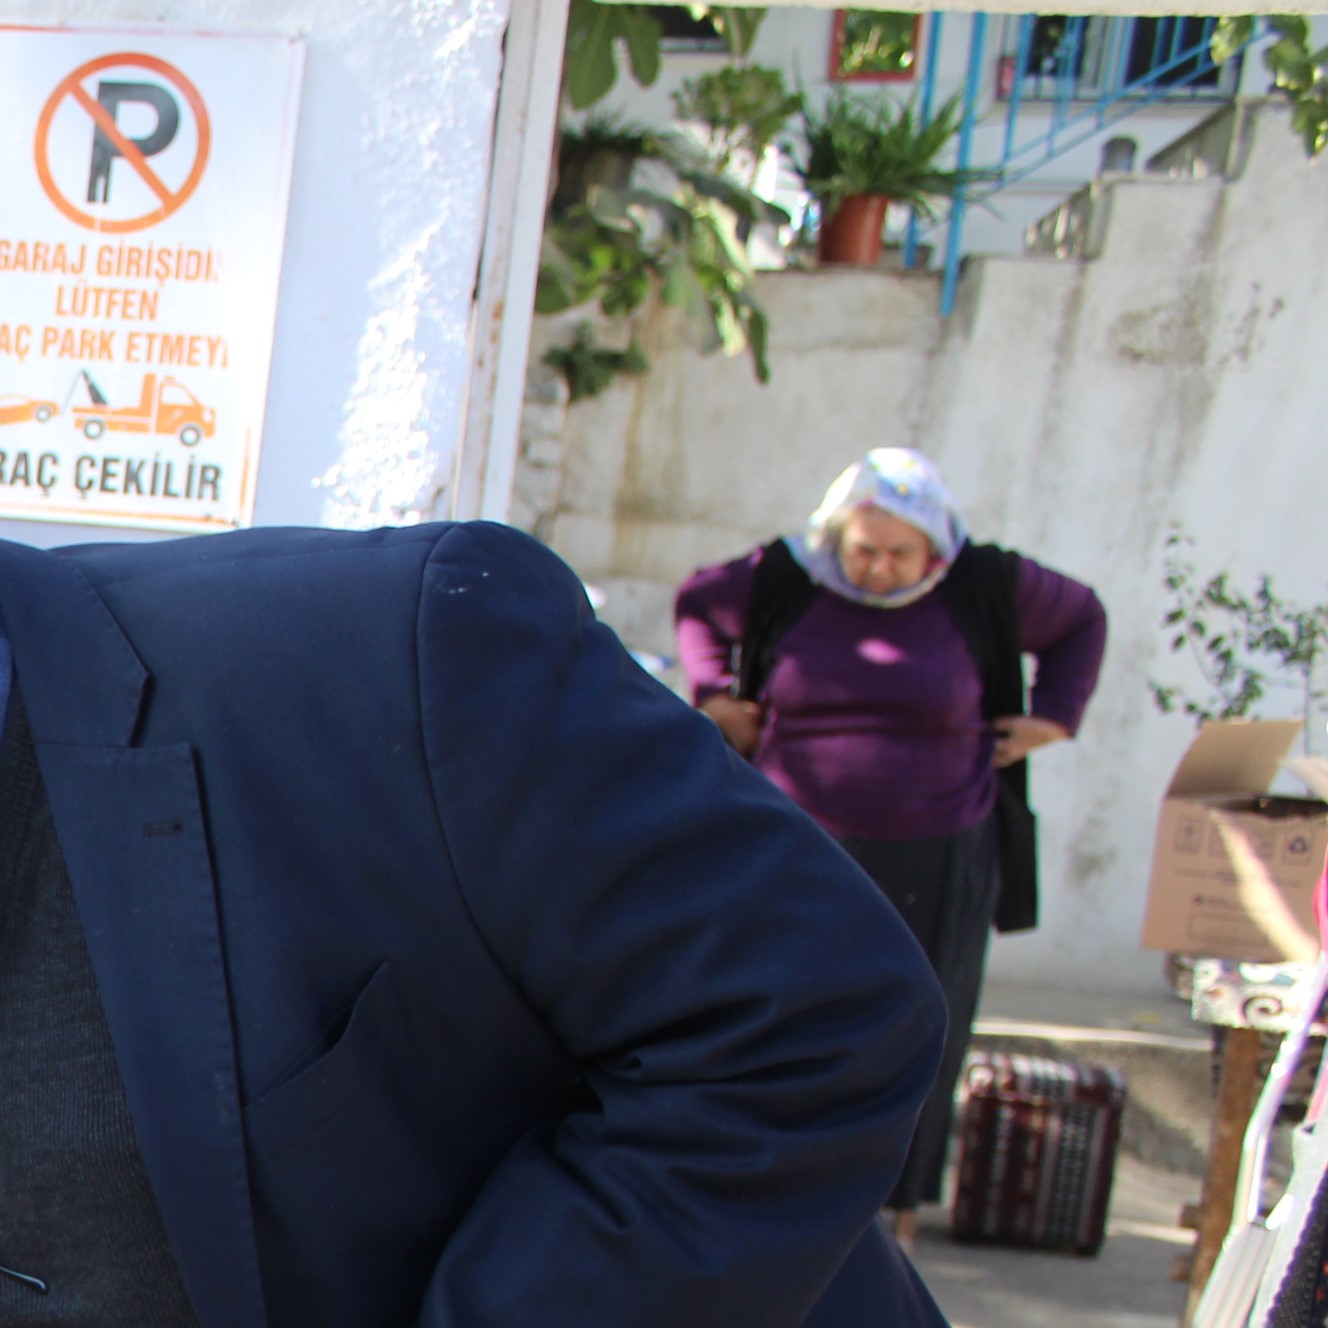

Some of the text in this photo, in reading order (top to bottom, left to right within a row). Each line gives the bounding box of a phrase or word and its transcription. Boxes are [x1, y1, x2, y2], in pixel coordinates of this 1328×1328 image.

[87, 81, 181, 204] P
[55, 279, 160, 321] LÜTFEN
[40, 326, 117, 361] PARK
[73, 451, 223, 502] ÇEKİLİR
